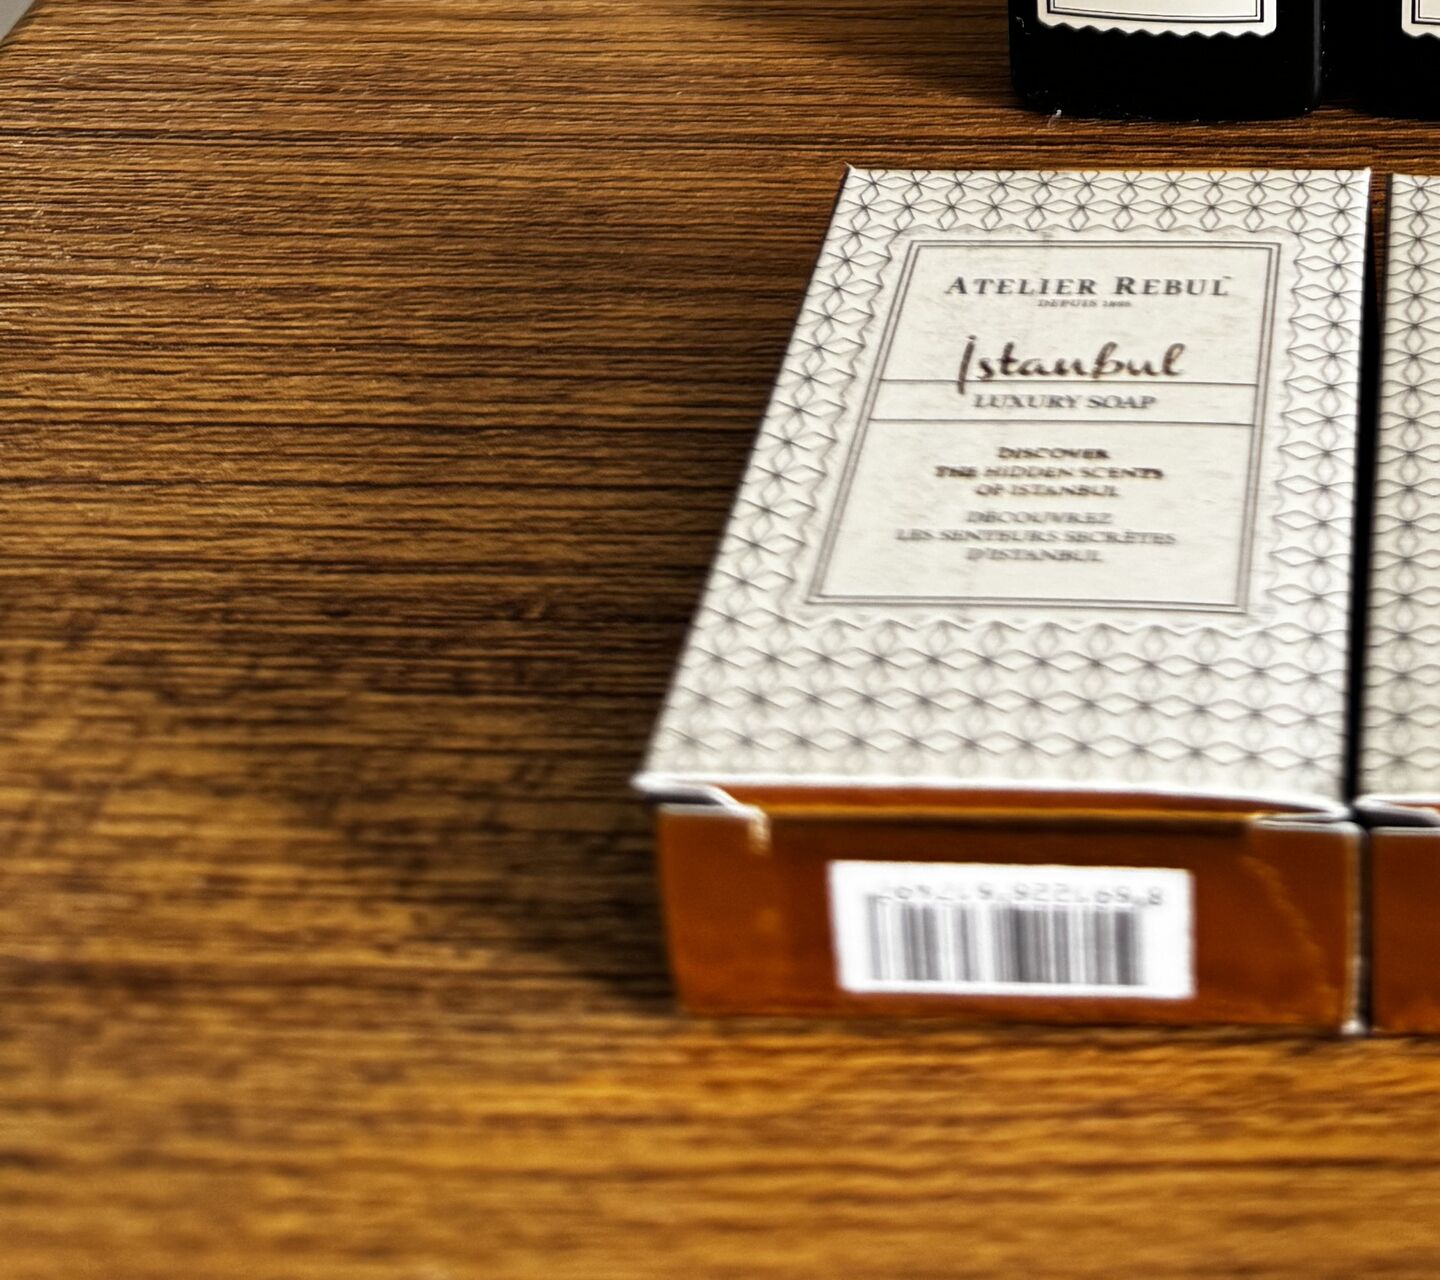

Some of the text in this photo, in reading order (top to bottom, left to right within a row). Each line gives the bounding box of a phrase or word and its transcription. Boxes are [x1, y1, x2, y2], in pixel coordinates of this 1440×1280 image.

[944, 276, 1229, 296] ATELIER REBUL
[973, 393, 1158, 410] LUXURY SOAP
